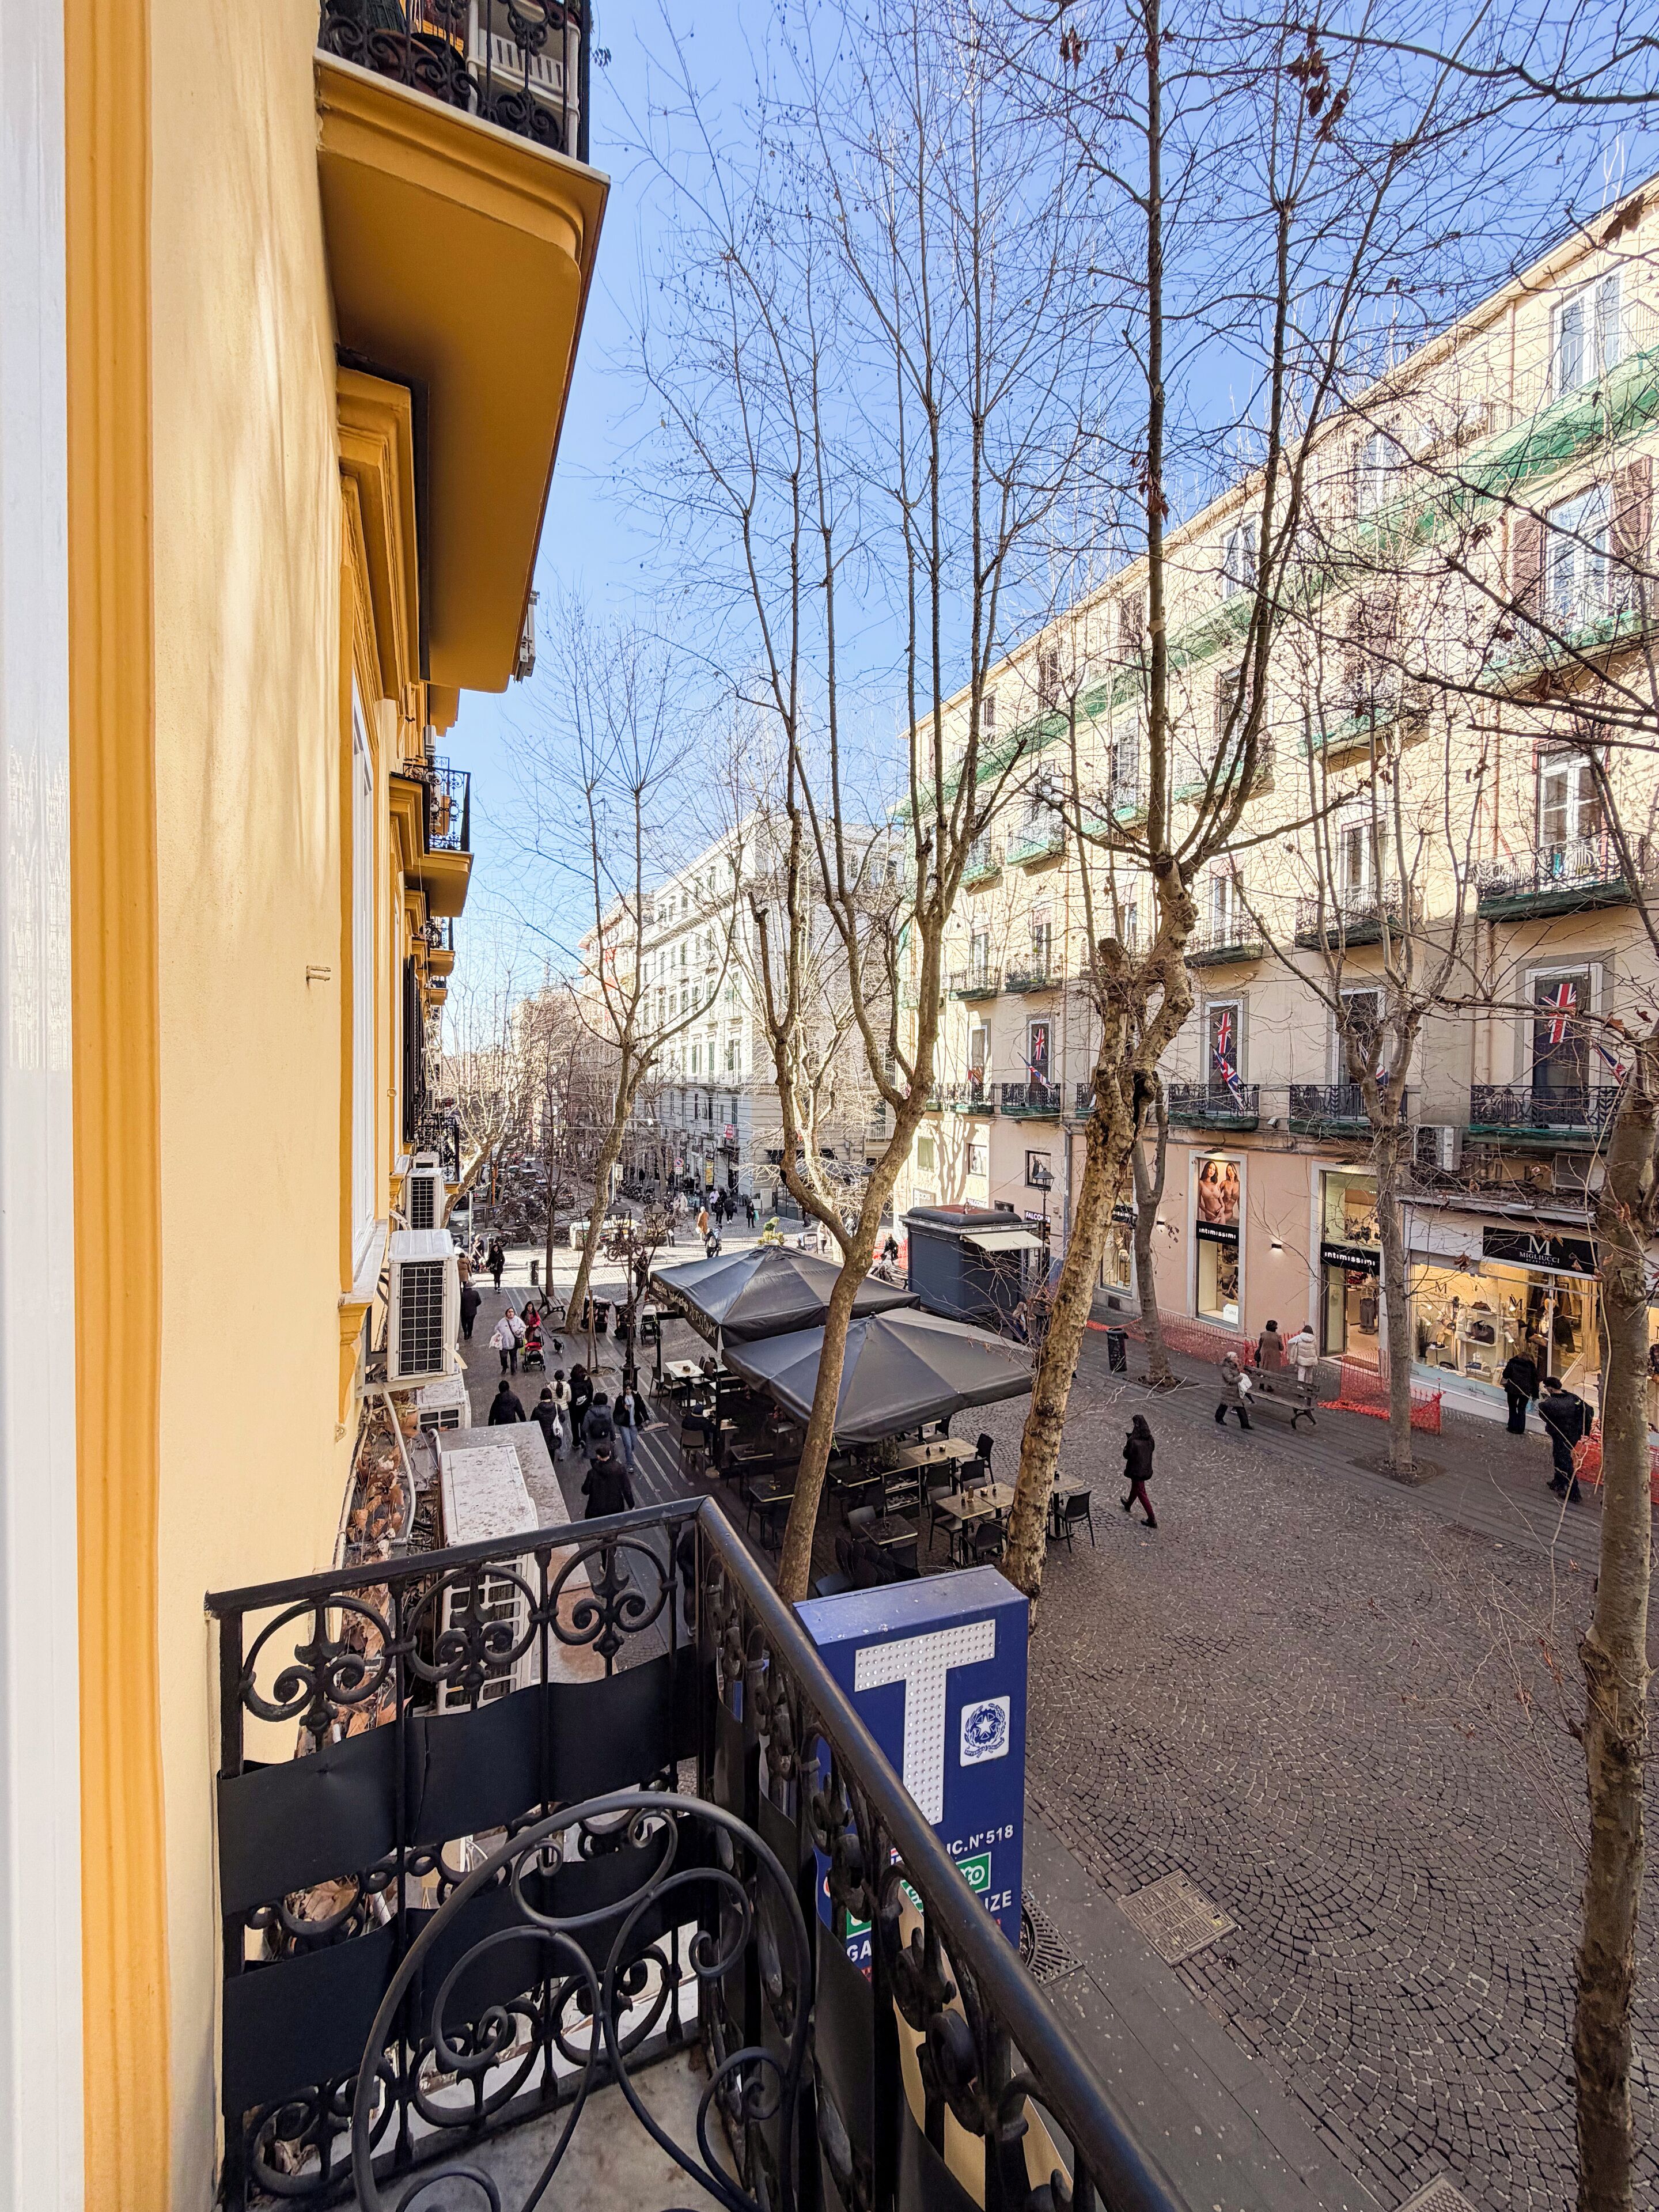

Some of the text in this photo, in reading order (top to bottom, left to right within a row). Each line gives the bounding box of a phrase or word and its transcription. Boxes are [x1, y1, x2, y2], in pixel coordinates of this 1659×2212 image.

[1199, 1228, 1236, 1239] intimissimi
[1526, 1234, 1552, 1256] M
[1324, 1251, 1376, 1266] intimissimi
[1519, 1251, 1560, 1264] MIGLIUCCI
[854, 1619, 996, 1825] T
